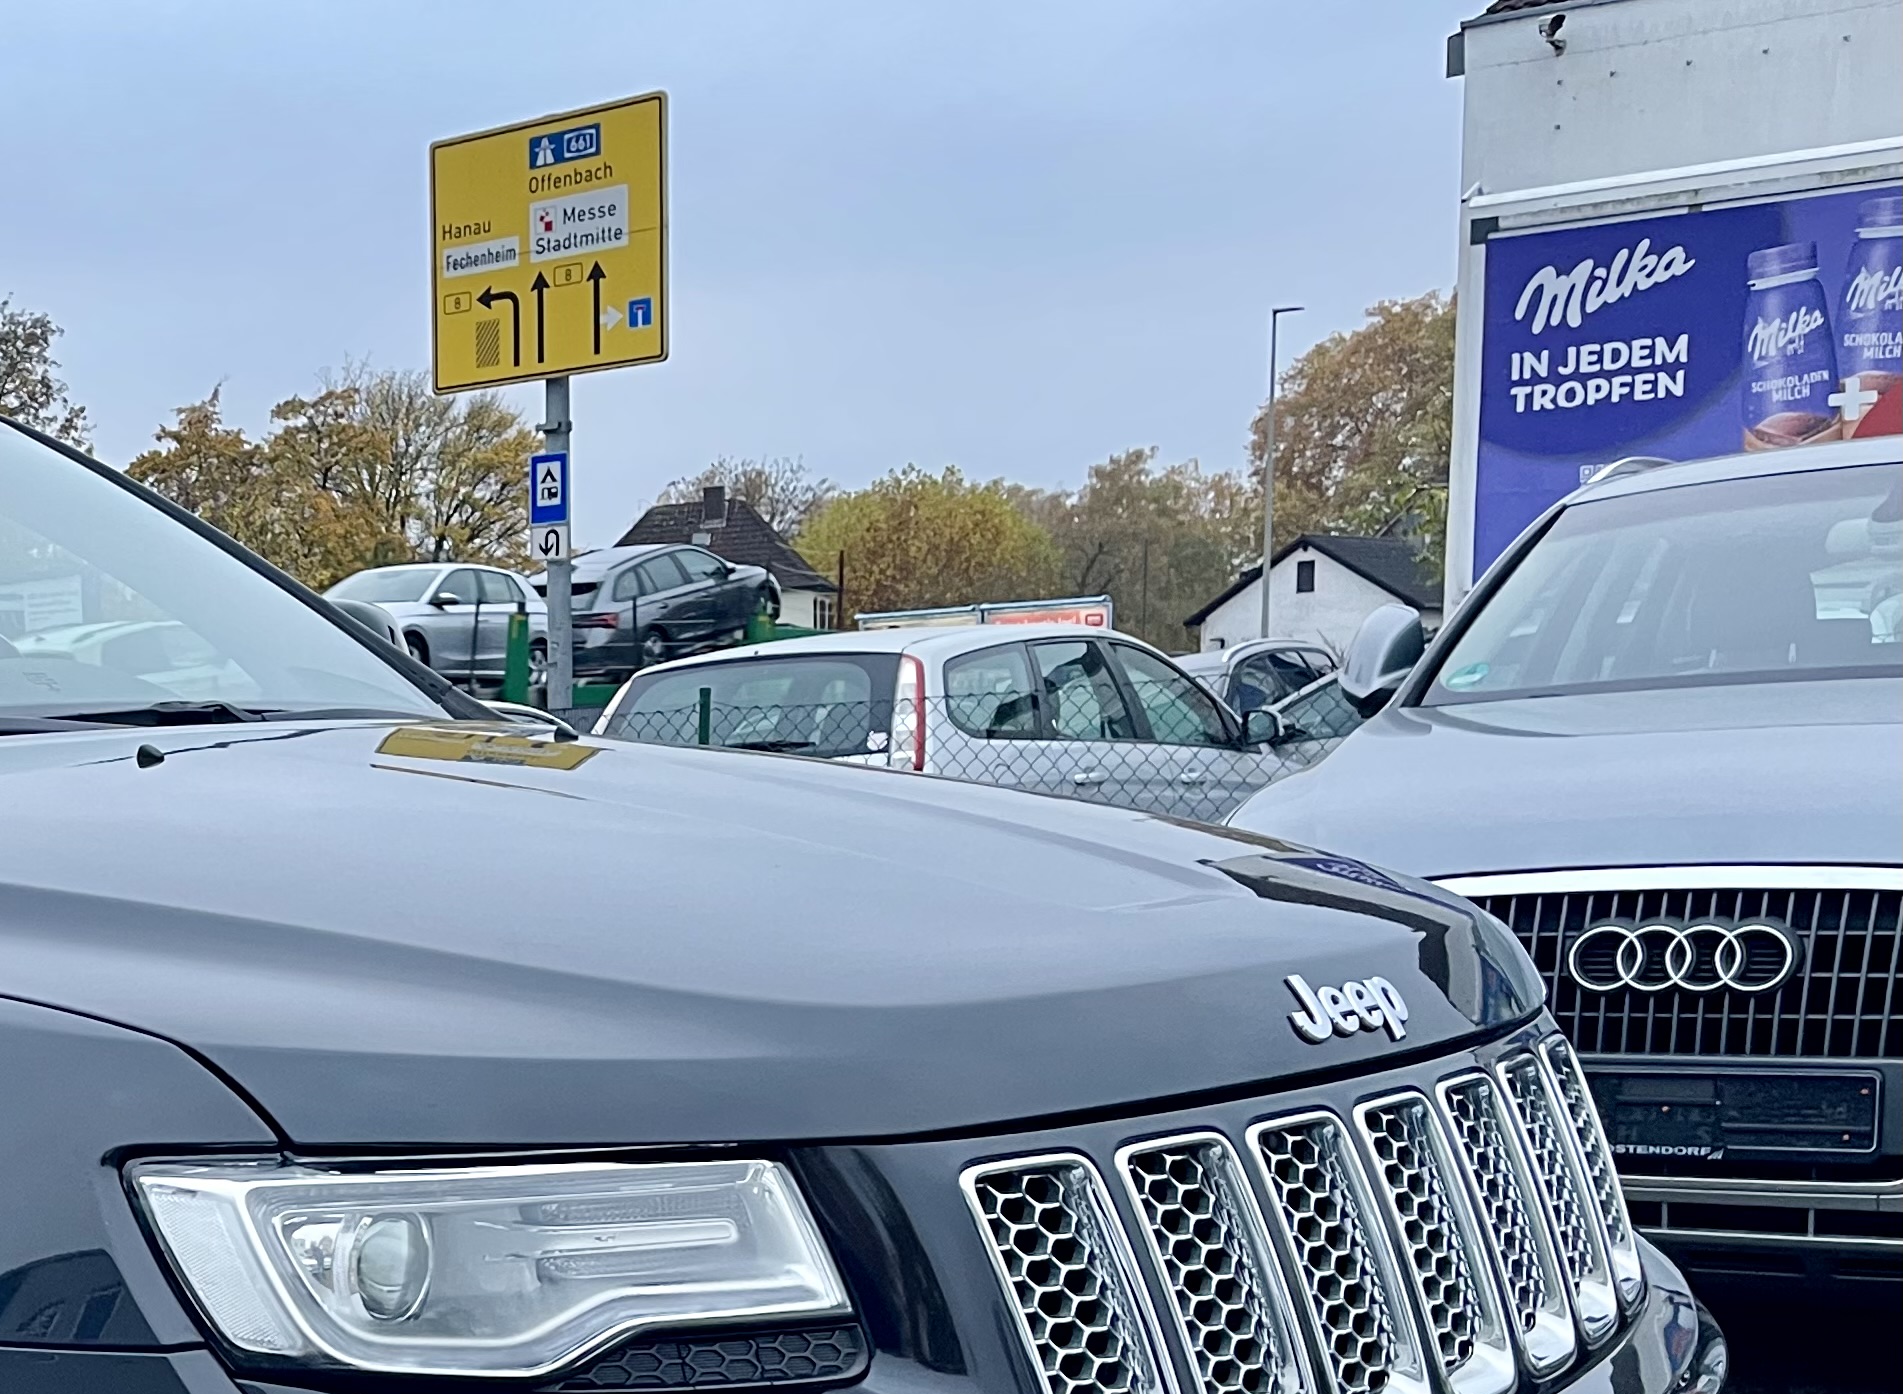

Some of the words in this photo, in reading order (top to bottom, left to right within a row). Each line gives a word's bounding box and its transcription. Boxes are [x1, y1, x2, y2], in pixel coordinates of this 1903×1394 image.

[568, 134, 592, 151] 661
[528, 162, 613, 193] Offenbach
[562, 202, 617, 225] Messe
[442, 220, 491, 241] Hanau
[535, 226, 623, 255] Stadtmitte
[446, 244, 516, 272] Fechenheim
[564, 267, 572, 282] 8
[1514, 238, 1696, 335] Milka
[1846, 265, 1903, 311] Mil
[454, 296, 461, 311] 8
[1747, 306, 1825, 361] Milka
[1511, 350, 1549, 381] IN
[1557, 334, 1689, 376] JEDEM
[1862, 345, 1901, 360] MILCH
[1510, 370, 1685, 413] TROPFEN
[1751, 369, 1830, 394] SCHOKOLADEN
[1772, 383, 1811, 403] MILCH
[1284, 974, 1409, 1045] Jeep
